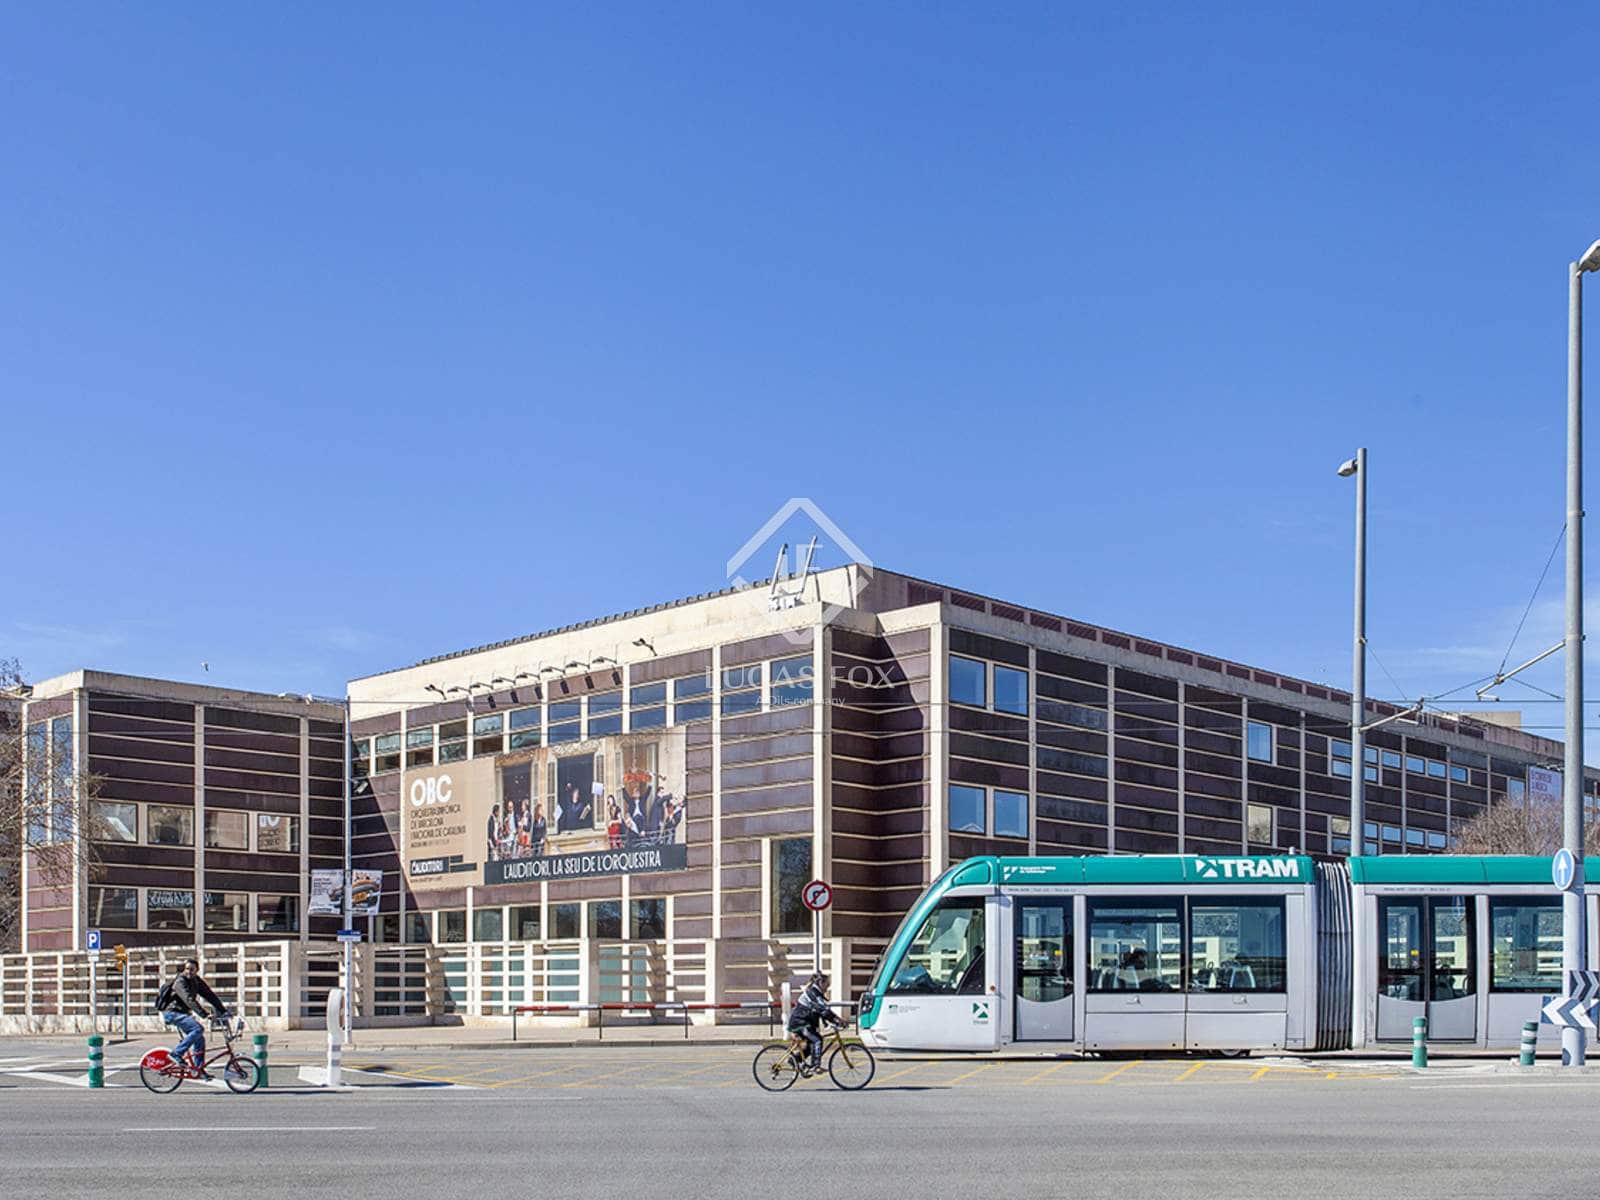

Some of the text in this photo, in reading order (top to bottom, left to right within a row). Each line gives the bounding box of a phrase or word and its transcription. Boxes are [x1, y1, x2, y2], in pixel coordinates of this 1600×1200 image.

[552, 859, 563, 875] LA
[564, 856, 581, 874] SEU
[582, 856, 596, 872] DE
[597, 850, 662, 872] L'ORQUESTRA
[1217, 859, 1299, 878] TRAM
[88, 933, 97, 948] P
